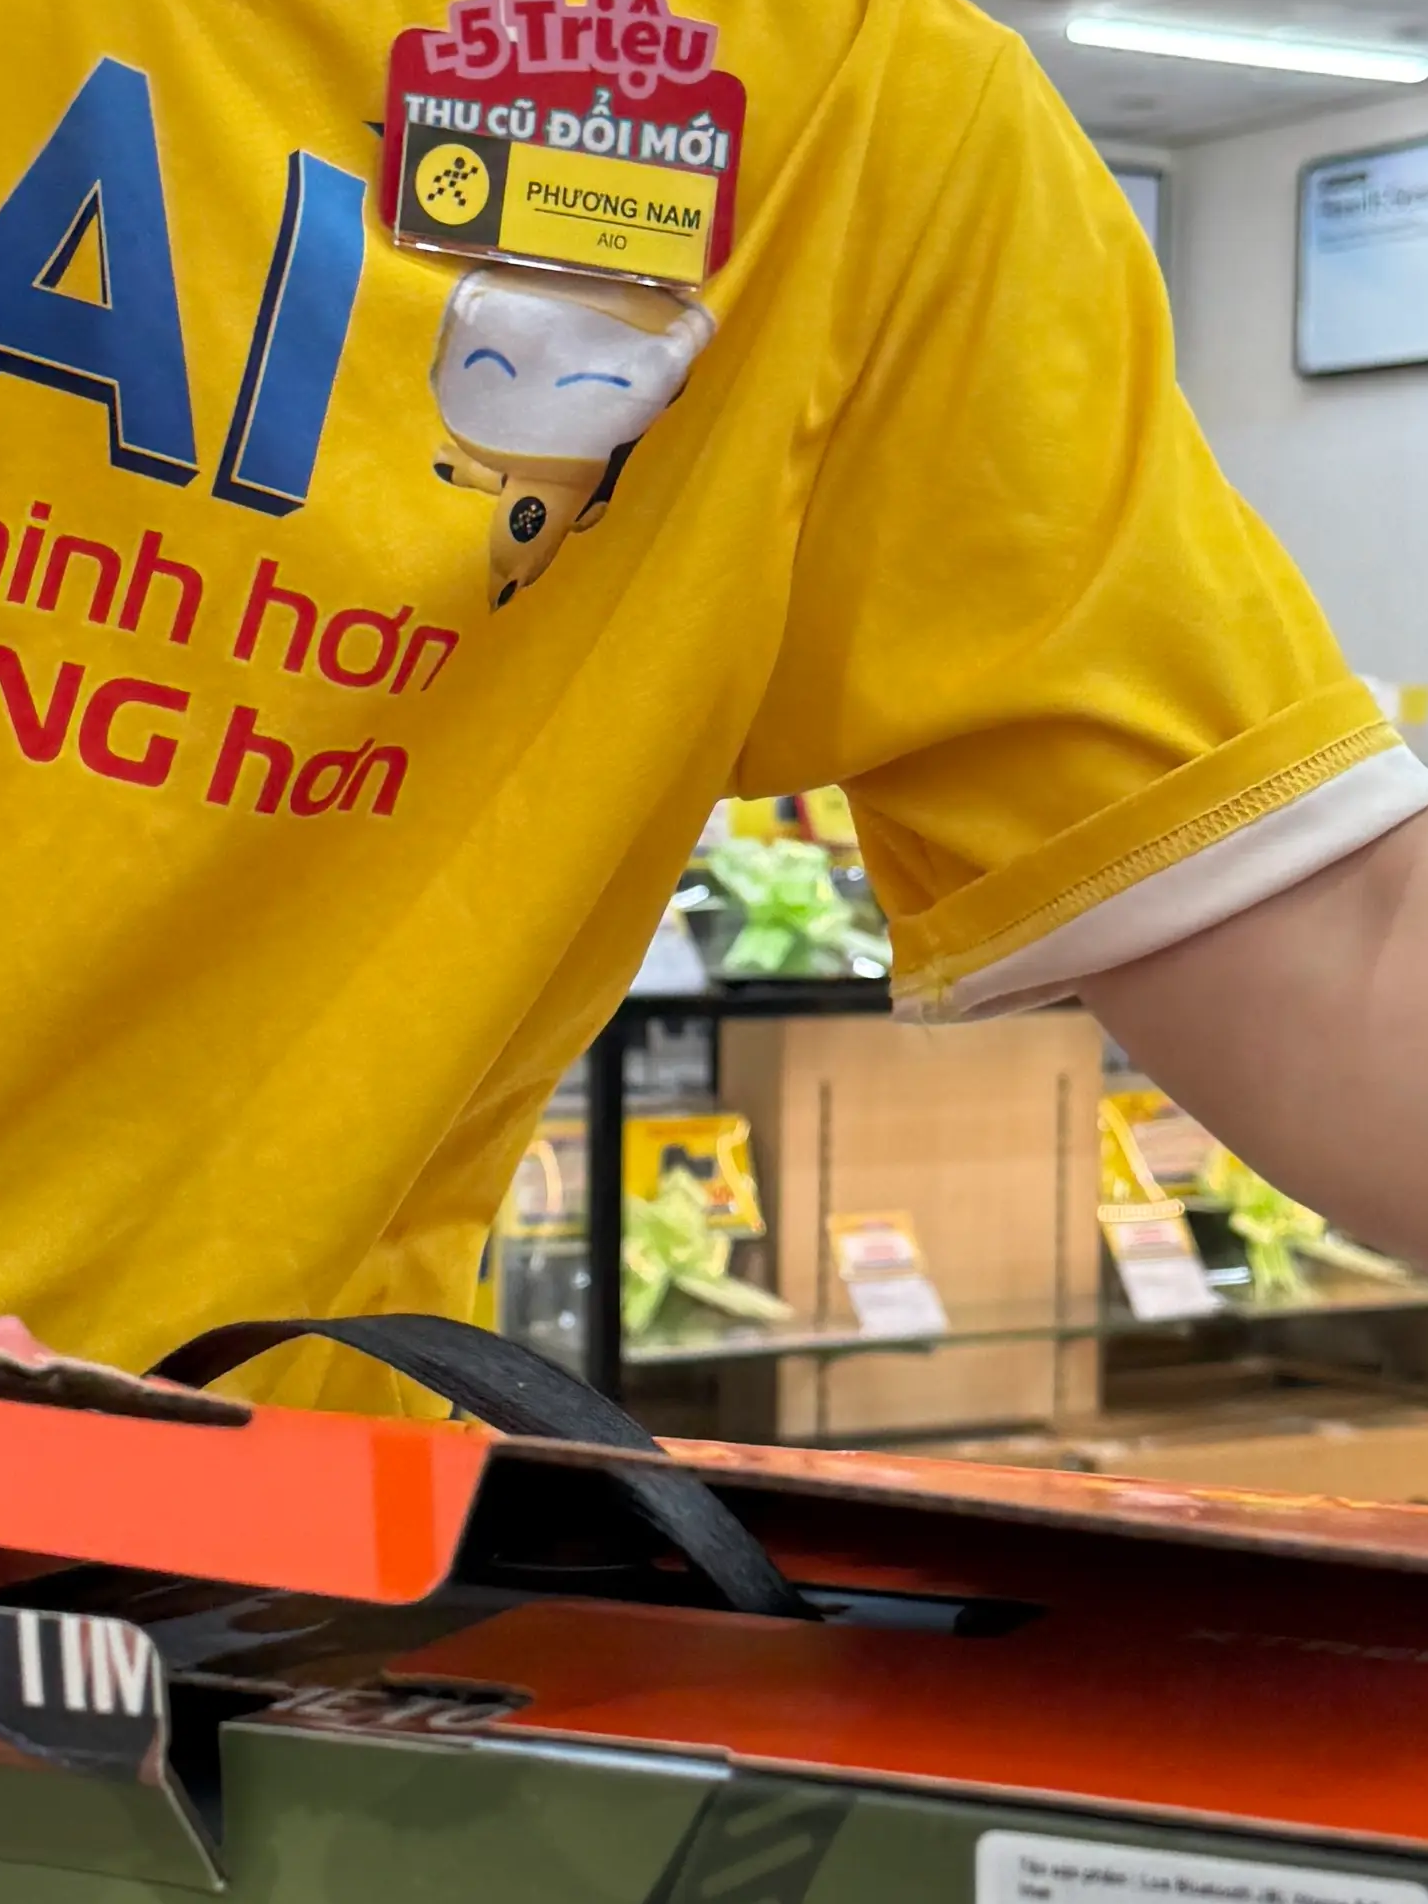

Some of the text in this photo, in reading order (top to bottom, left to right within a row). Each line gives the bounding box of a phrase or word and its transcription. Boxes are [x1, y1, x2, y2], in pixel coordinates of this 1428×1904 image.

[403, 86, 730, 171] THU CŨ ĐỔI MỚI
[526, 180, 702, 231] PHƯƠNG NAM
[597, 232, 628, 251] AIO
[232, 554, 461, 697] hơn
[205, 704, 410, 820] hơn
